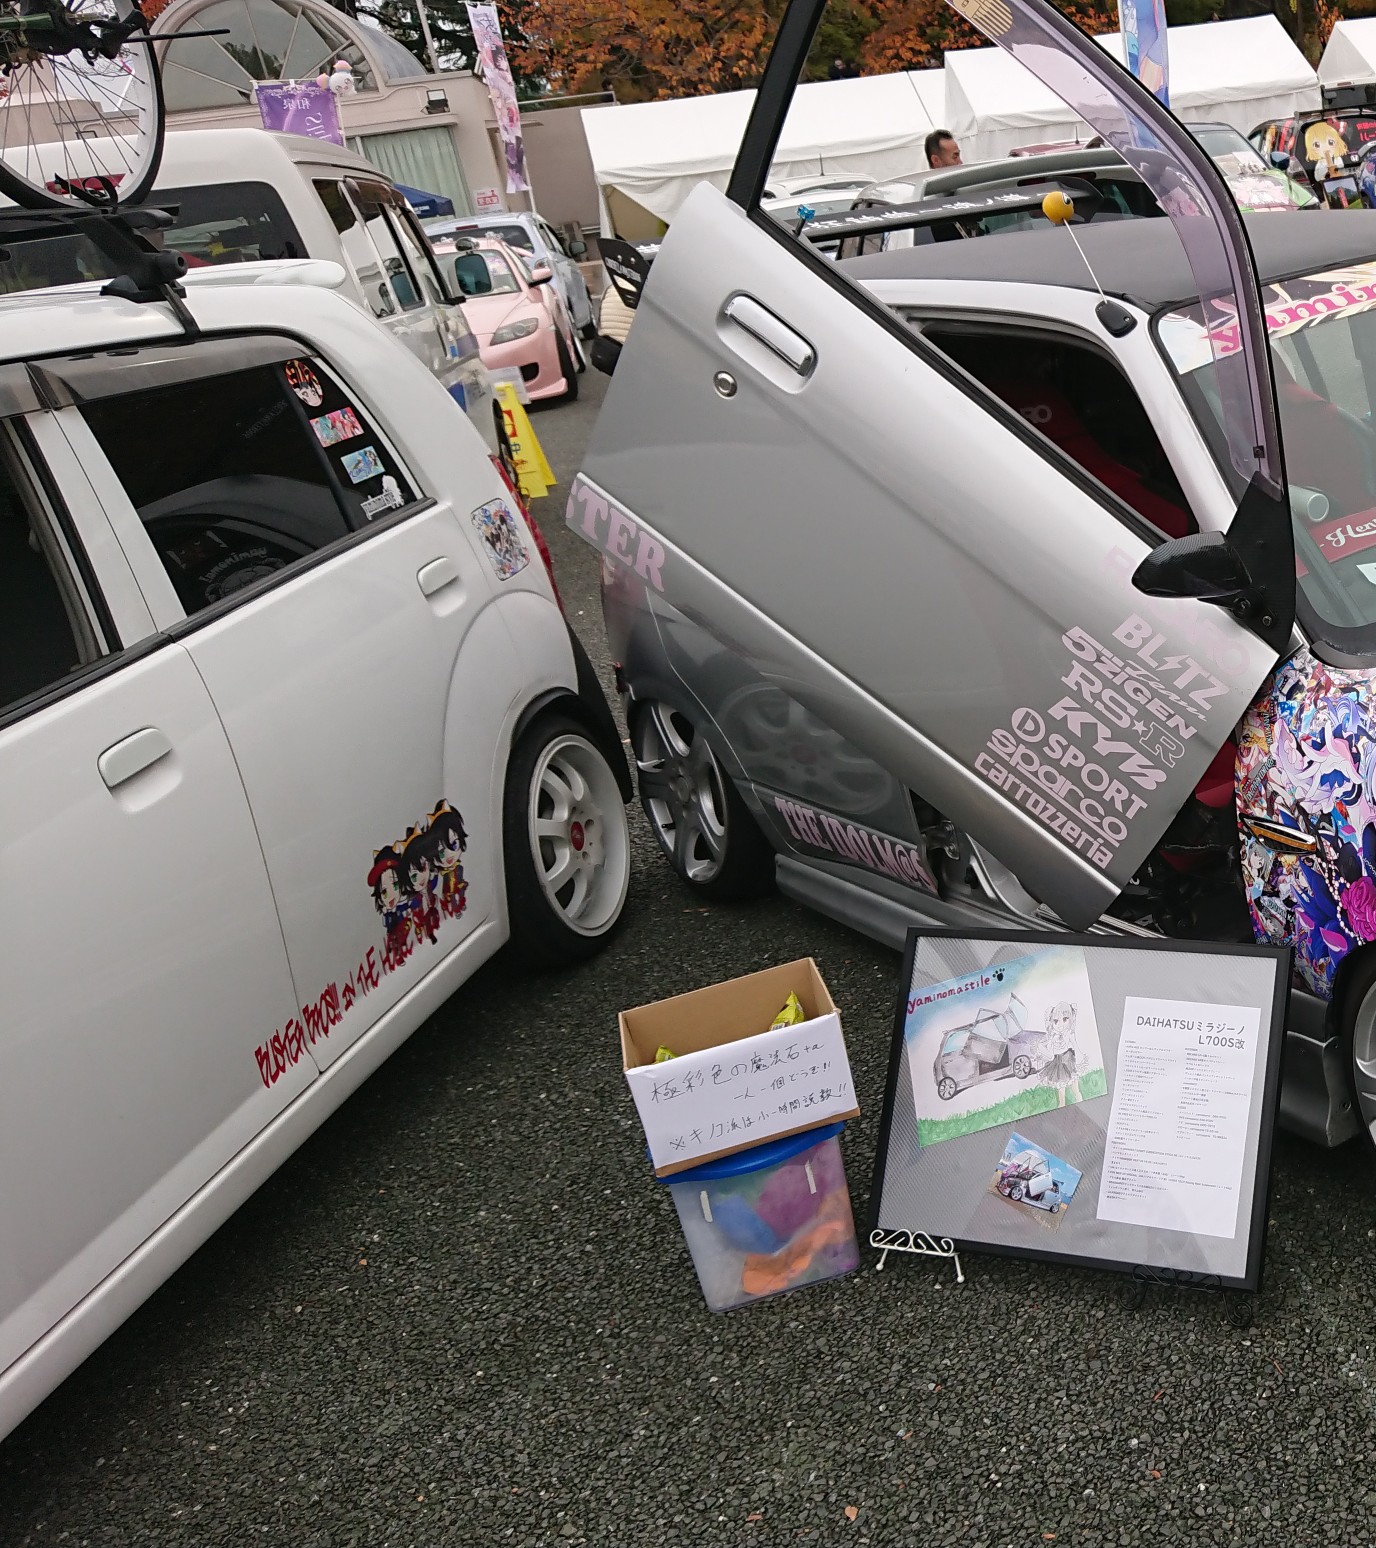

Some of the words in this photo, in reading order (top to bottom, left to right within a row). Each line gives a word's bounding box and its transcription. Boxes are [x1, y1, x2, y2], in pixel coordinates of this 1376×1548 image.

[1112, 612, 1230, 711] BLITZ
[987, 728, 1128, 842] sparco
[1043, 733, 1148, 820] SPORT
[1047, 695, 1168, 790] KYB
[775, 796, 833, 851] THE
[974, 752, 1114, 870] carrozzeria
[254, 1018, 305, 1088] BUSTER
[357, 946, 380, 997] THE
[906, 974, 991, 1014] yaminomastile
[1198, 1035, 1246, 1050] L700S改
